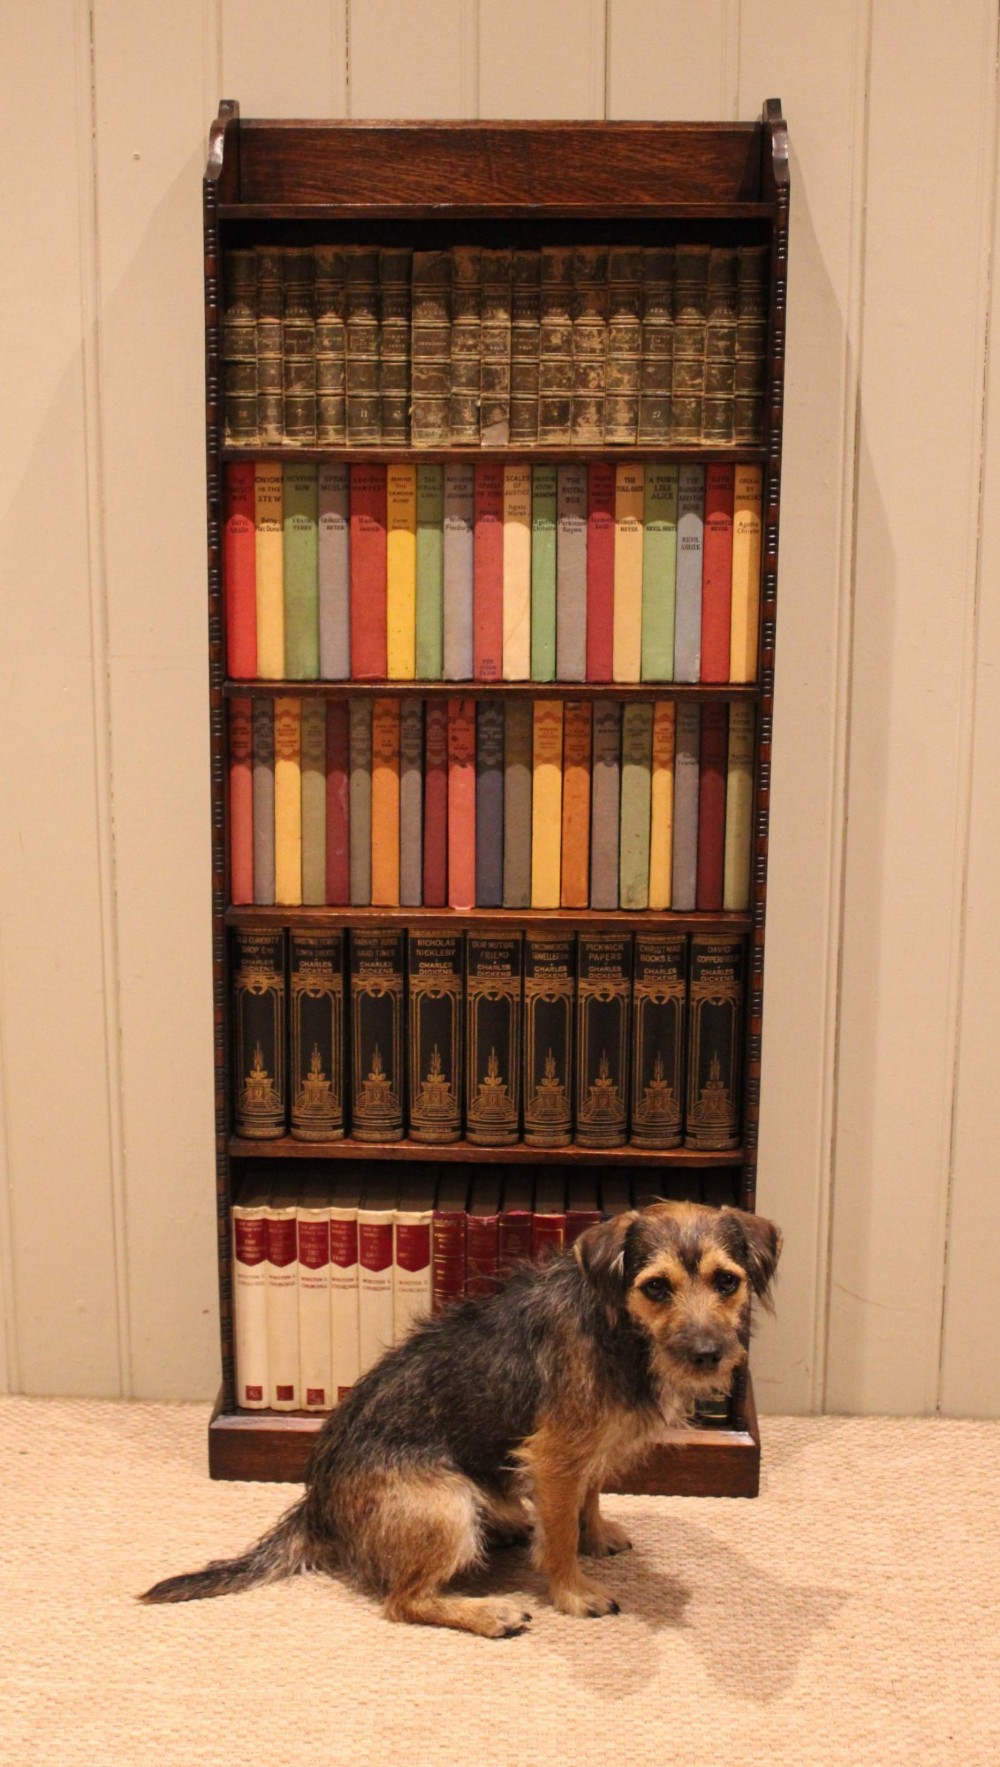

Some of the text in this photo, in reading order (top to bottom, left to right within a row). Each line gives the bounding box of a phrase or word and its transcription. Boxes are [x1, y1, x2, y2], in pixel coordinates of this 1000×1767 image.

[257, 495, 282, 503] STEW
[565, 496, 581, 504] BOX
[739, 521, 758, 529] Agatha
[417, 939, 456, 947] NICHOLAS
[472, 941, 515, 949] OUR MUTUAL
[586, 943, 624, 951] PICKWICK
[415, 949, 457, 957] NICKLEBY
[639, 944, 681, 954] CHRISTMAS
[707, 945, 732, 953] DAVID
[480, 950, 510, 959] FRIEND
[588, 953, 622, 961] PAPERS
[640, 955, 665, 963] BOOKS
[696, 955, 739, 963] COPPERFIELD
[477, 963, 511, 971] CHARLES
